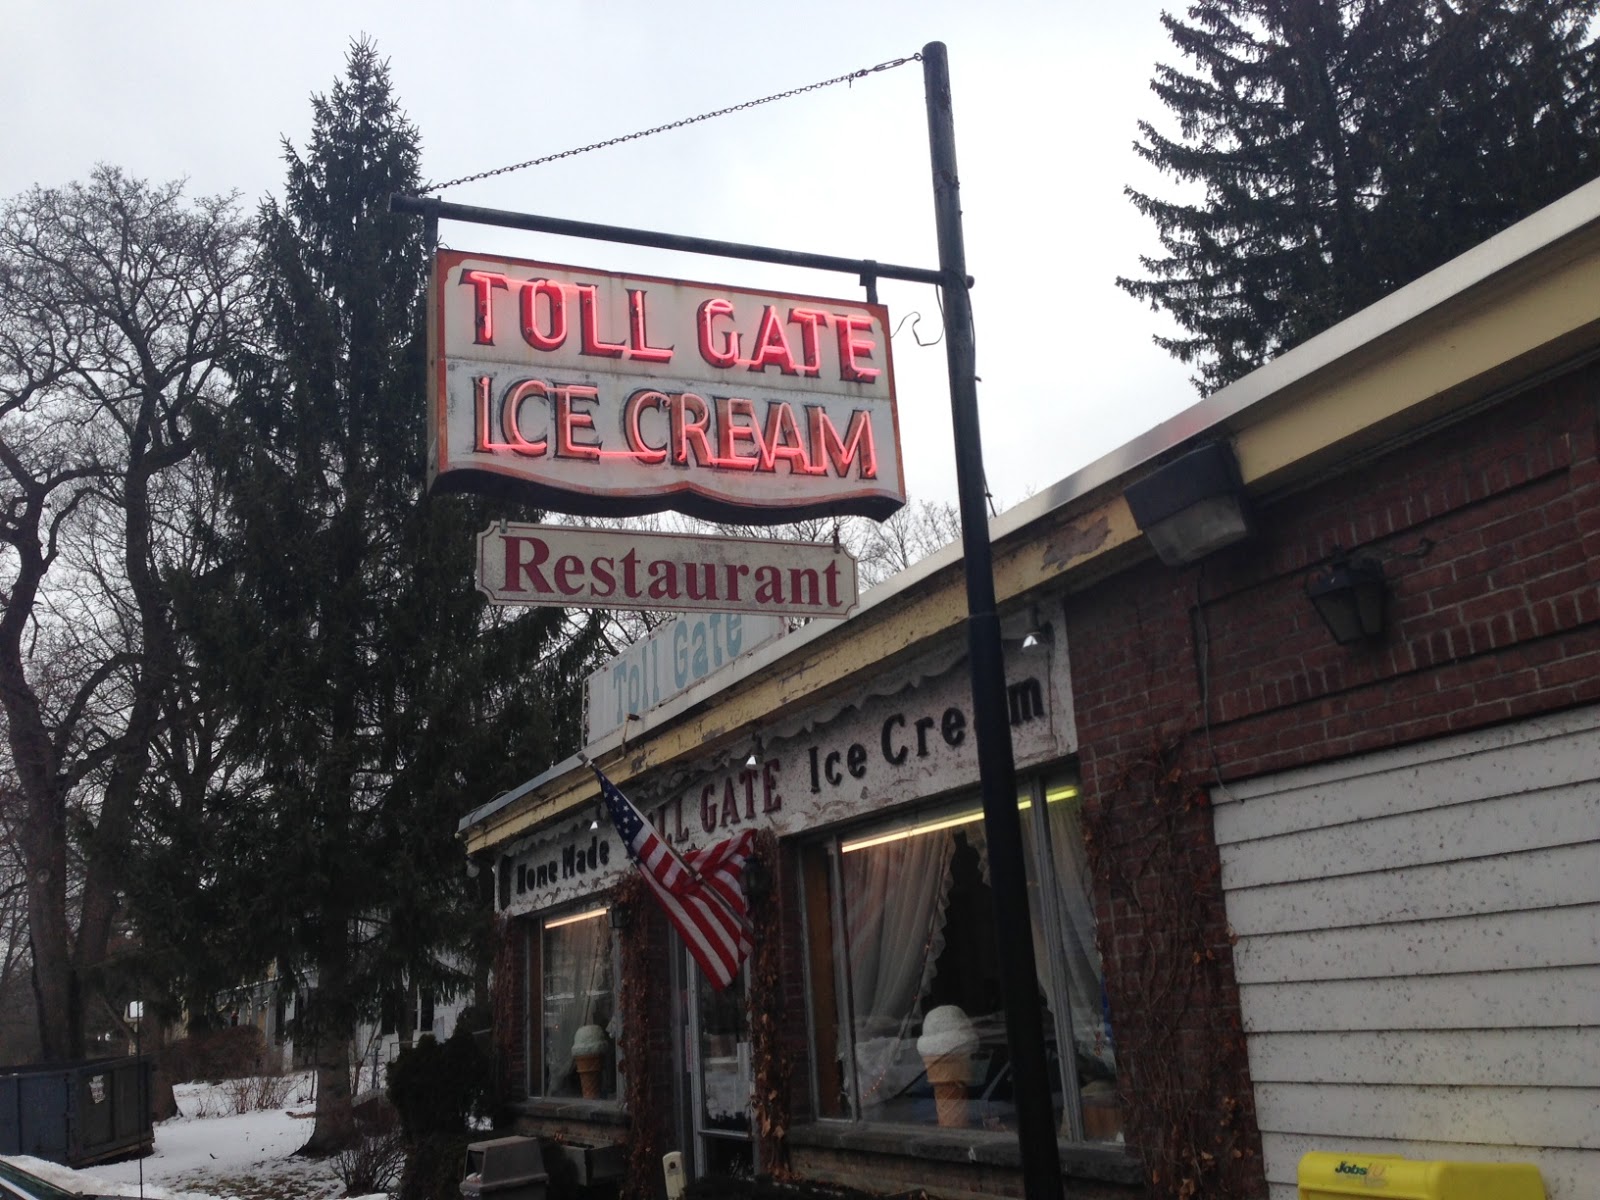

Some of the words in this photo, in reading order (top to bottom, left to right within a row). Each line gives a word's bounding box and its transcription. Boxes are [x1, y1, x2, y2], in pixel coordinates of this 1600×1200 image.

[459, 269, 674, 364] TOLL
[697, 298, 881, 383] GATE
[473, 376, 603, 460] ICE
[624, 388, 878, 480] CREAM
[499, 536, 843, 607] Restaurant
[613, 640, 660, 725] Toll
[674, 613, 742, 689] Gate
[562, 836, 609, 880] Made
[700, 758, 783, 833] GATE
[808, 743, 867, 795] Ice
[881, 677, 1044, 766] Crem
